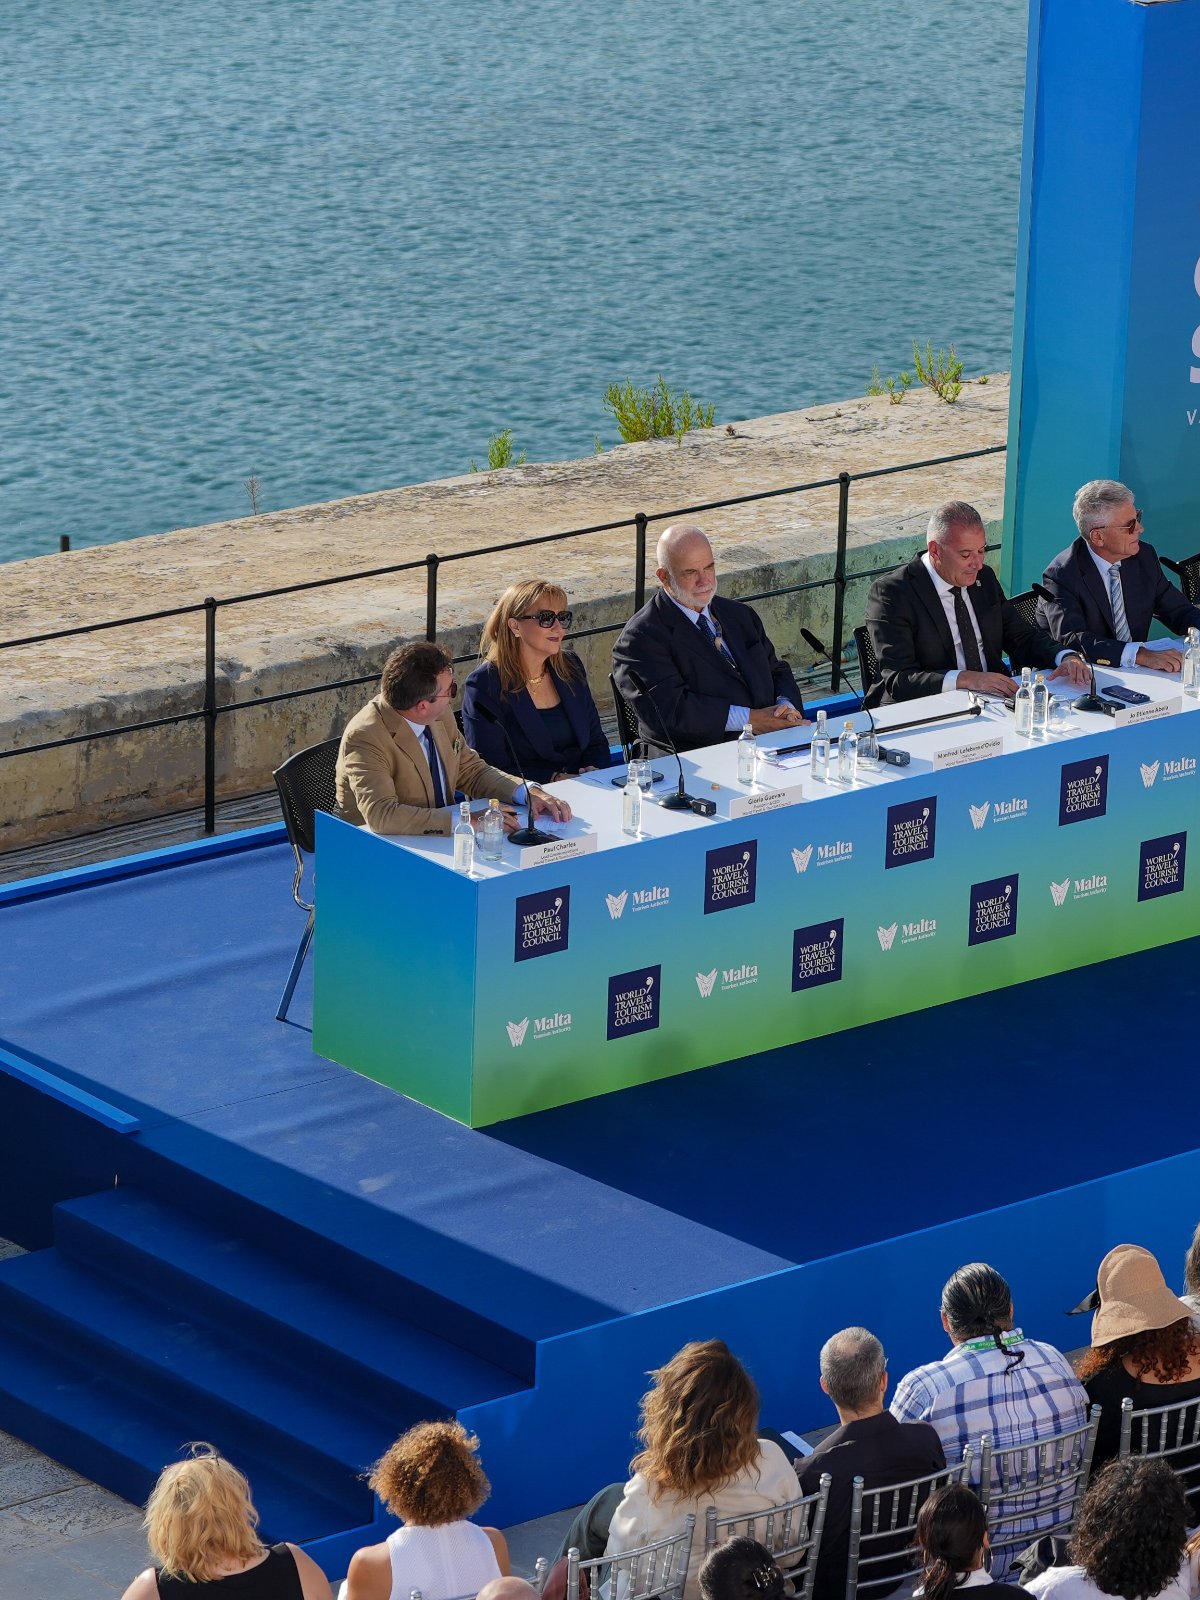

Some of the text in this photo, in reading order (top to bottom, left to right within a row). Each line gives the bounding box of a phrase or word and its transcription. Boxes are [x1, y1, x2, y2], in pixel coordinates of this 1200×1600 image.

[1163, 757, 1196, 775] Malta
[1066, 782, 1101, 798] TRAVEL &
[1067, 776, 1096, 790] WORLD
[1066, 790, 1101, 806] TOURISM
[1066, 798, 1101, 813] COUNCIL
[993, 798, 1028, 817] Malta
[893, 818, 923, 832] WORLD
[893, 824, 929, 840] TRAVEL &
[544, 842, 576, 854] Paul Charles
[892, 832, 929, 848] TOURISM
[892, 840, 929, 856] COUNCIL
[817, 841, 853, 860] Malta
[1145, 859, 1179, 874] TRAVEL &
[1146, 852, 1174, 867] WORLD
[712, 862, 743, 877] WORLD
[712, 868, 749, 885] TRAVEL &
[1144, 866, 1178, 882] TOURISM
[711, 877, 749, 893] TOURISM
[1073, 875, 1107, 894] Malta
[1144, 874, 1178, 890] COUNCIL
[632, 886, 670, 906] Malta
[711, 885, 749, 901] COUNCIL
[976, 895, 1006, 910] WORLD
[976, 902, 1011, 918] TRAVEL &
[522, 915, 561, 932] TRAVEL &
[523, 908, 555, 924] WORLD
[975, 910, 1011, 926] TOURISM
[522, 923, 562, 940] TOURISM
[901, 919, 937, 938] Malta
[975, 917, 1011, 933] COUNCIL
[522, 931, 562, 949] COUNCIL
[800, 940, 830, 955] WORLD
[799, 947, 836, 963] TRAVEL &
[799, 955, 836, 971] TOURISM
[721, 965, 758, 984] Malta
[799, 962, 836, 979] COUNCIL
[615, 987, 647, 1003] WORLD
[615, 994, 653, 1011] TRAVEL &
[614, 1002, 653, 1019] TOURISM
[614, 1010, 653, 1027] COUNCIL
[533, 1013, 572, 1033] Malta
